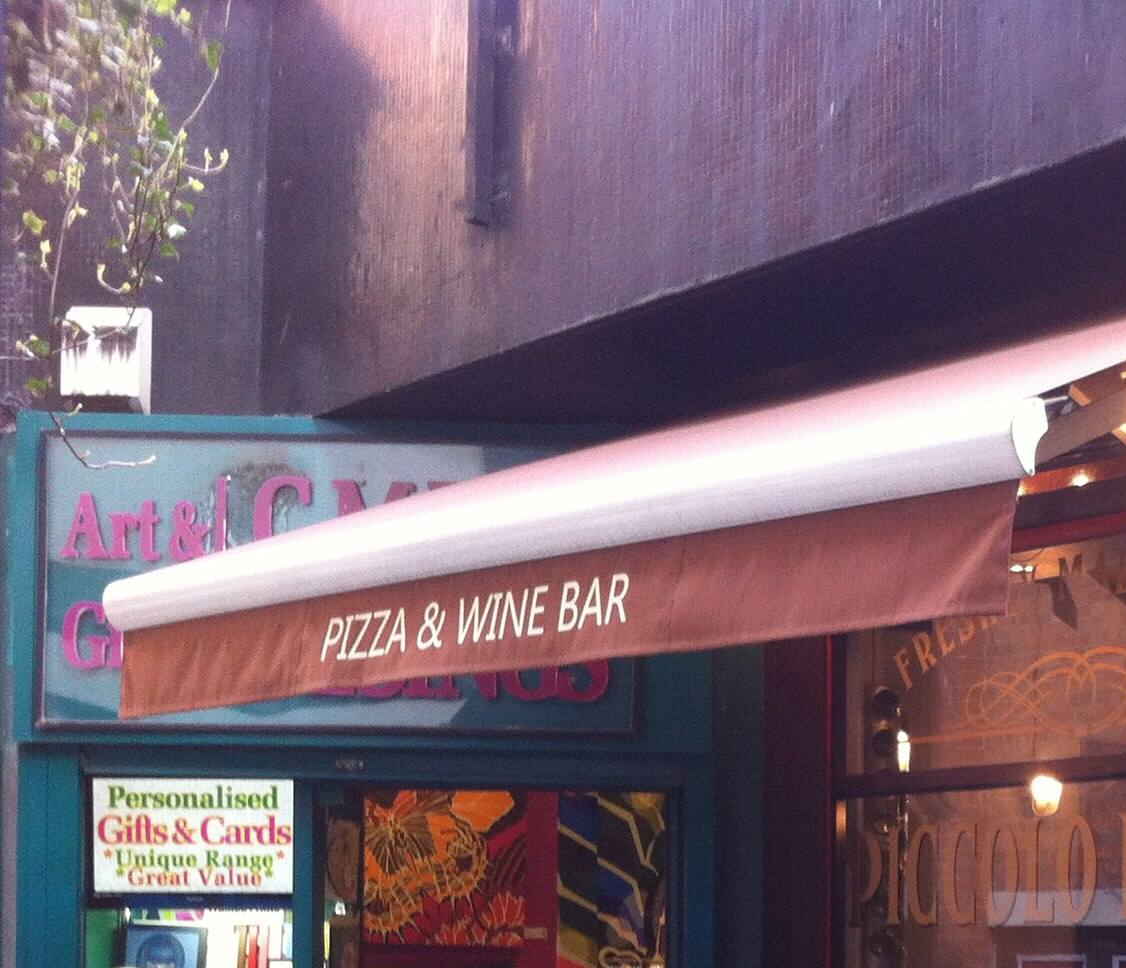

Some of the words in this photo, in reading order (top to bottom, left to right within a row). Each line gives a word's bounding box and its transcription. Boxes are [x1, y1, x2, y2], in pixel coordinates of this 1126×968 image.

[61, 491, 162, 561] Art
[169, 500, 209, 561] &
[320, 608, 406, 662] PIZZA
[416, 602, 446, 650] &
[457, 585, 549, 646] WINE
[557, 573, 630, 633] BAR
[98, 814, 168, 845] Gifts
[172, 817, 197, 845] &
[200, 815, 292, 845] Cards
[107, 785, 279, 810] Personalised
[846, 814, 1097, 927] PICCOLO
